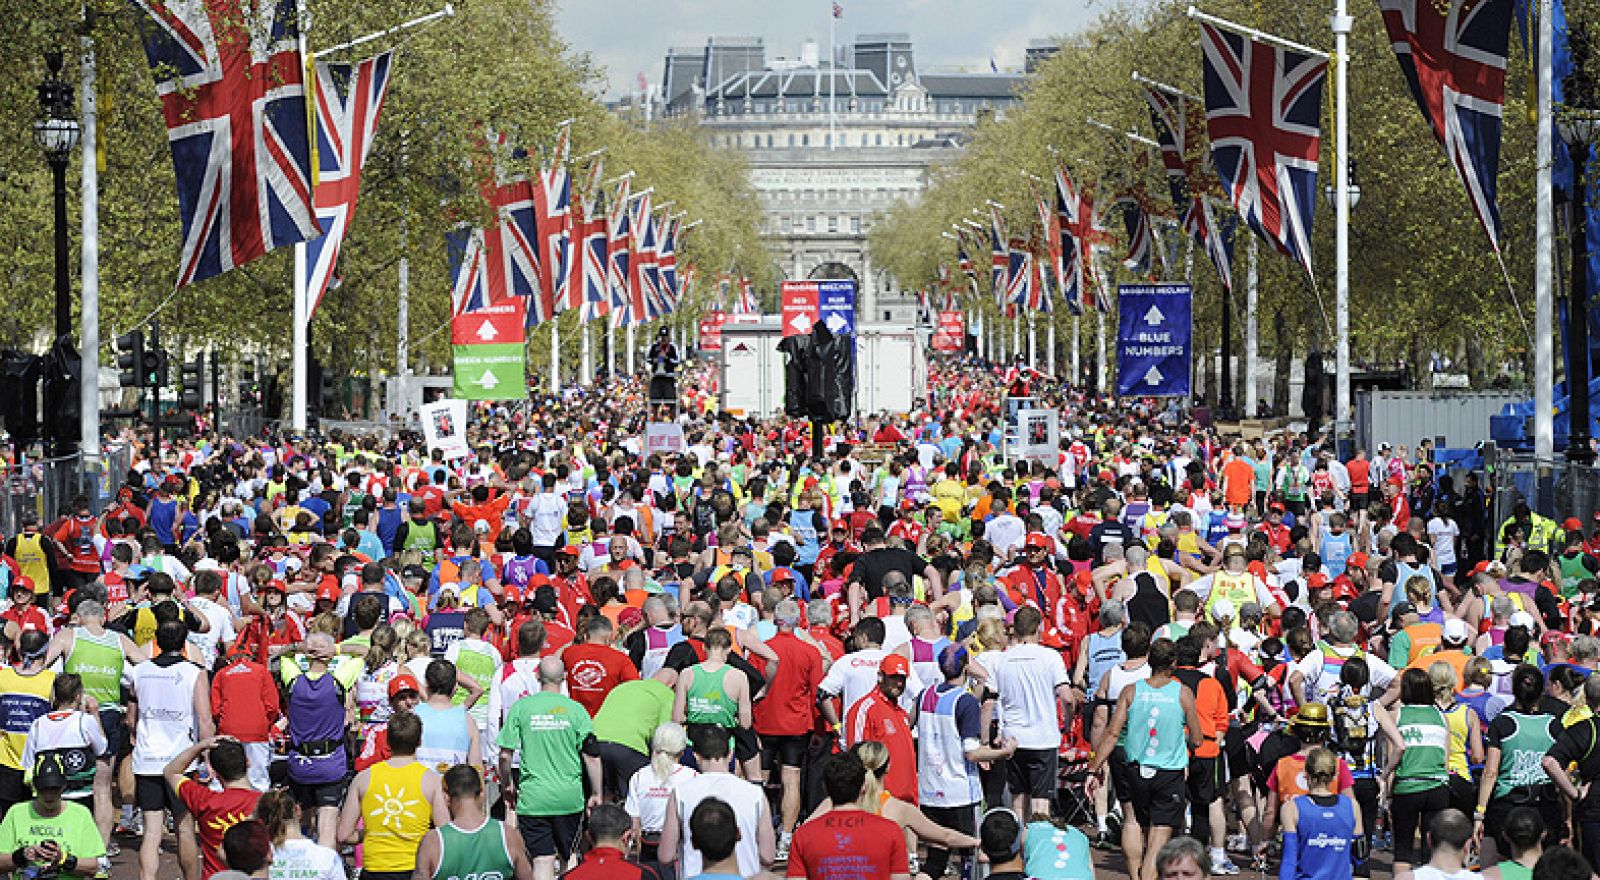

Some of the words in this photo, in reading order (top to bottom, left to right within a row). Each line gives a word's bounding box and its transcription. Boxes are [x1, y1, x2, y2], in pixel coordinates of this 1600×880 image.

[1139, 331, 1170, 343] BLUE
[1125, 345, 1184, 357] NUMBERS
[825, 816, 865, 828] RICH
